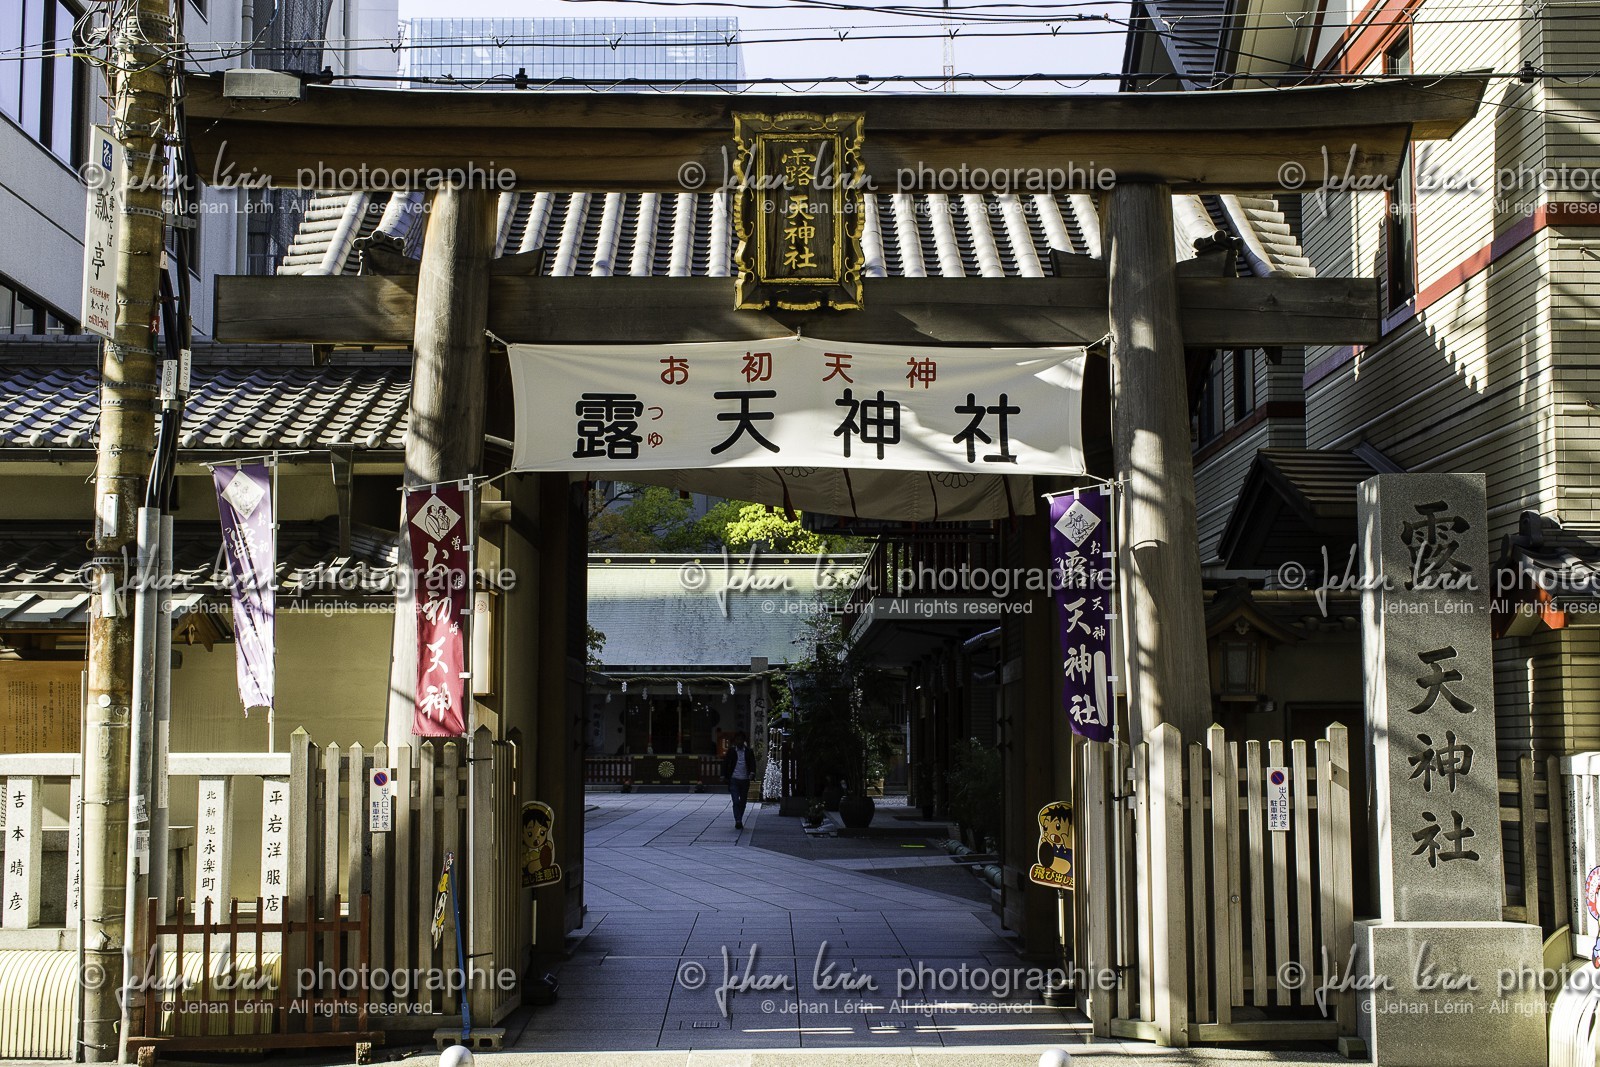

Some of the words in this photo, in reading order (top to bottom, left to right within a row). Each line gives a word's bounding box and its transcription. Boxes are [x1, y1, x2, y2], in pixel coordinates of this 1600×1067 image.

[781, 148, 818, 269] 露天神社
[659, 352, 937, 390] お初天神
[571, 388, 1021, 465] 露天神社
[647, 406, 664, 448] つゆ
[419, 542, 452, 723] お初天神
[1060, 549, 1100, 726] 露天神社
[1089, 540, 1107, 642] お初天神
[1400, 499, 1480, 869] 露天神社
[9, 790, 26, 911] 吉本晴彦
[202, 790, 217, 905] 北新地永楽町
[264, 790, 283, 912] 平岩洋服店
[372, 801, 380, 829] 駐車禁止
[381, 787, 390, 831] 出入口に付き
[1270, 799, 1278, 828] 駐車禁止
[1278, 786, 1287, 828] 出入口に付き
